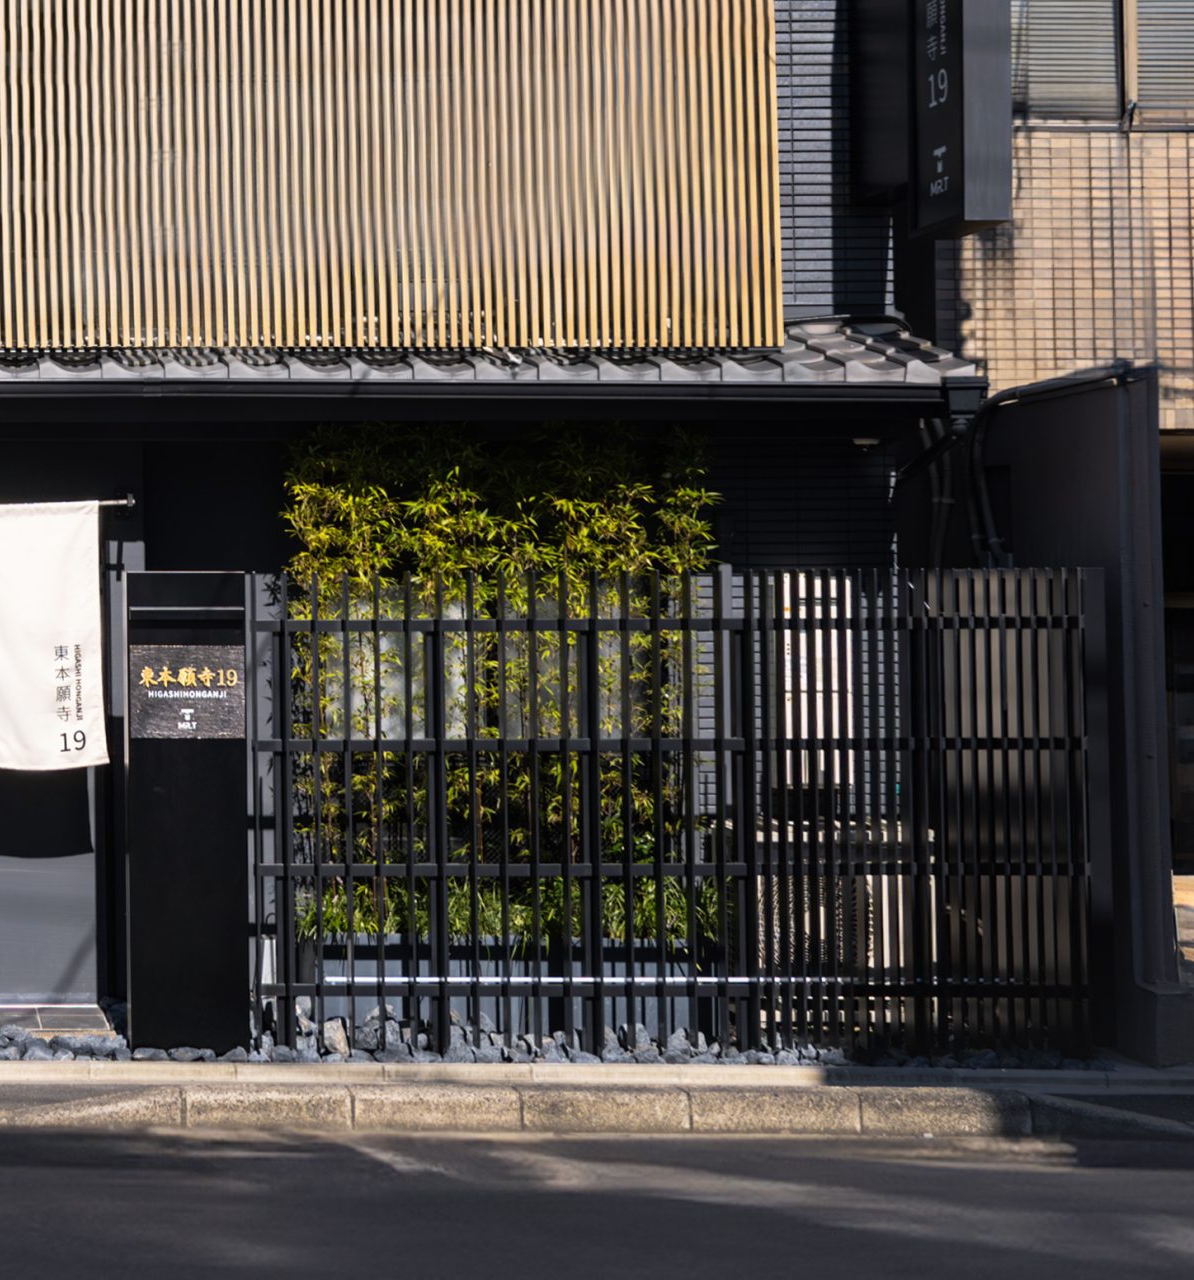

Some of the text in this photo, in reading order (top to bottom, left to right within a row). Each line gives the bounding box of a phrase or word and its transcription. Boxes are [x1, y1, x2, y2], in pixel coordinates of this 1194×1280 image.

[928, 68, 948, 108] 19
[54, 645, 72, 721] 東本願寺
[74, 644, 83, 720] HIGASHI HONGANJI
[148, 690, 227, 699] HIGASHIHONGANJI
[60, 730, 86, 752] 19
